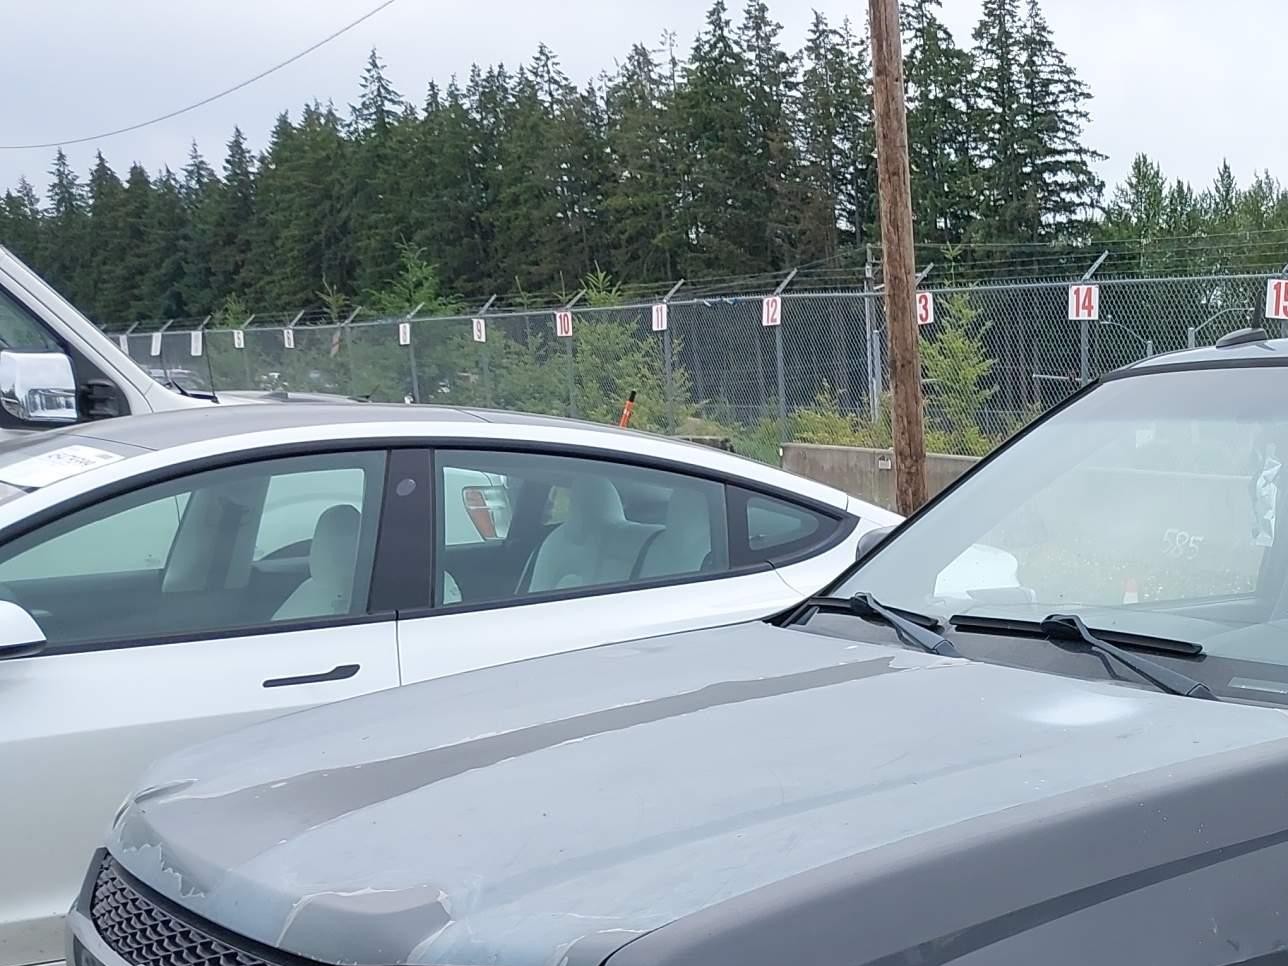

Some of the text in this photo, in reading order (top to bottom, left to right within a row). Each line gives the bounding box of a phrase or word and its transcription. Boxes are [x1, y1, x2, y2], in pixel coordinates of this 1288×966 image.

[766, 298, 778, 322] 12
[919, 295, 929, 323] 3
[1073, 287, 1095, 318] 14
[558, 313, 570, 335] 10
[655, 305, 664, 329] 11
